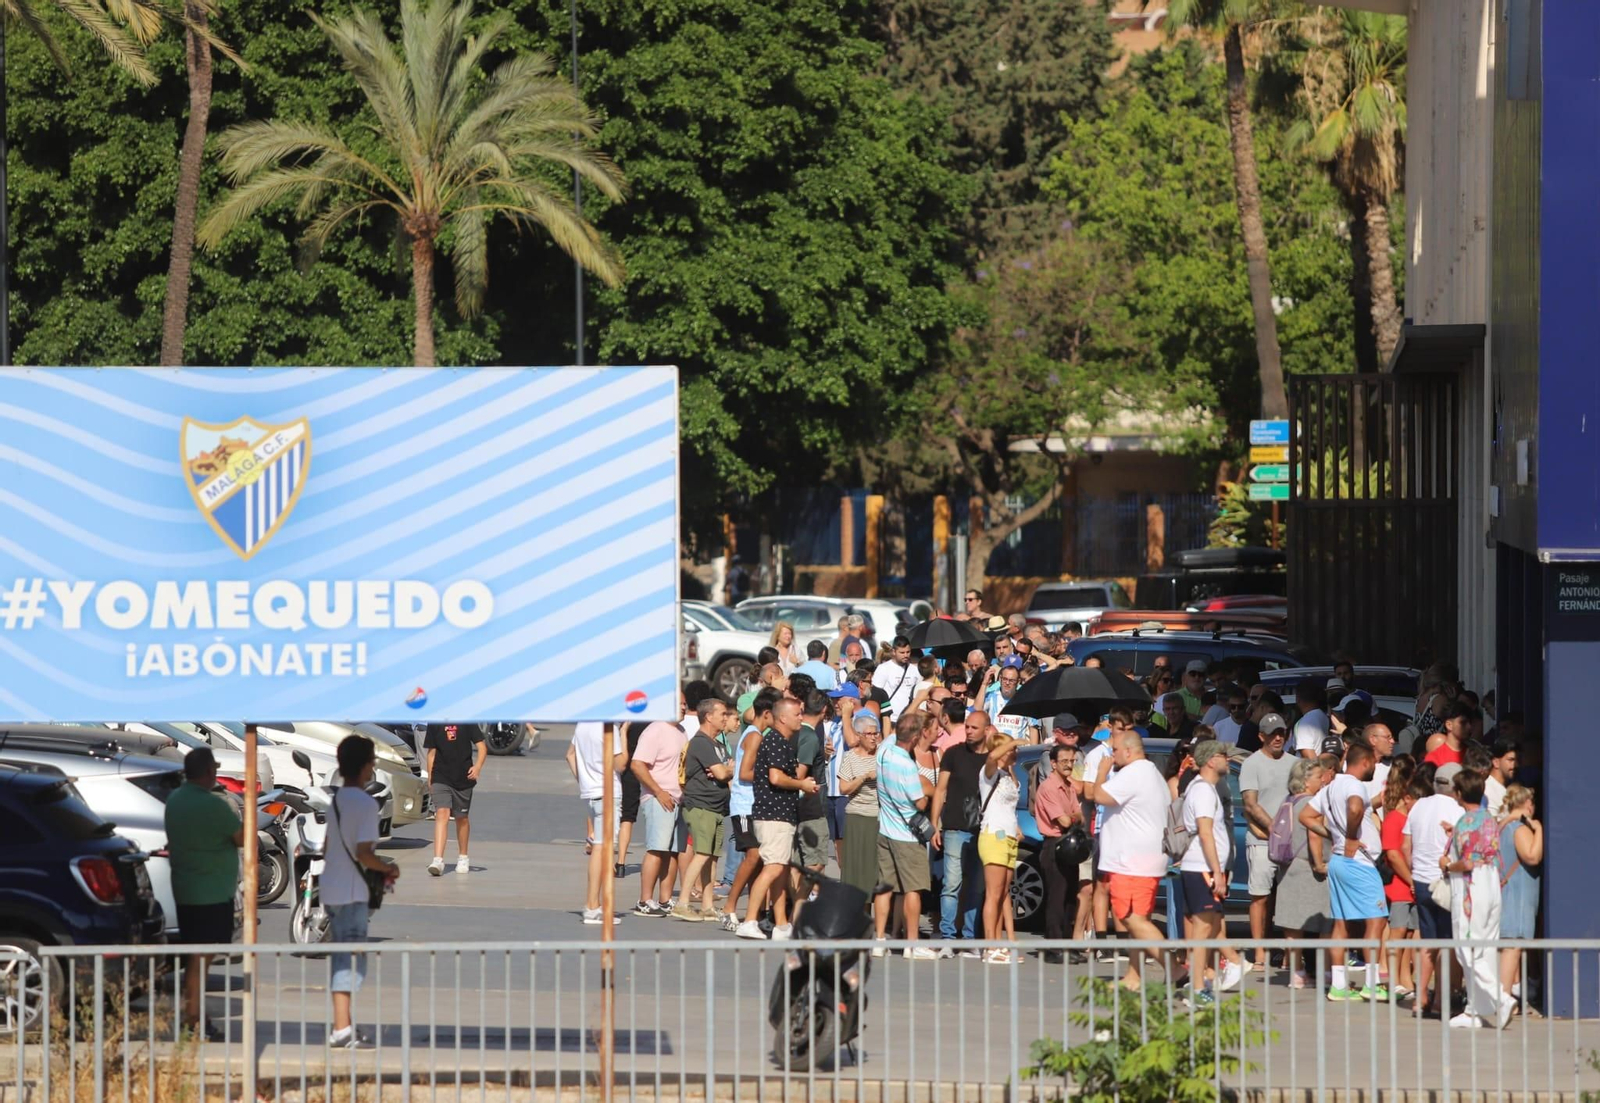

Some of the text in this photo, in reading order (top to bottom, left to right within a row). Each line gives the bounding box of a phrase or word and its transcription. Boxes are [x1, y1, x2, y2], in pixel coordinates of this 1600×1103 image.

[205, 452, 264, 500] MALAGA
[1559, 572, 1590, 585] Pasaje
[1559, 587, 1600, 597] ANTONIO
[0, 578, 495, 633] #YOMEQUEDO
